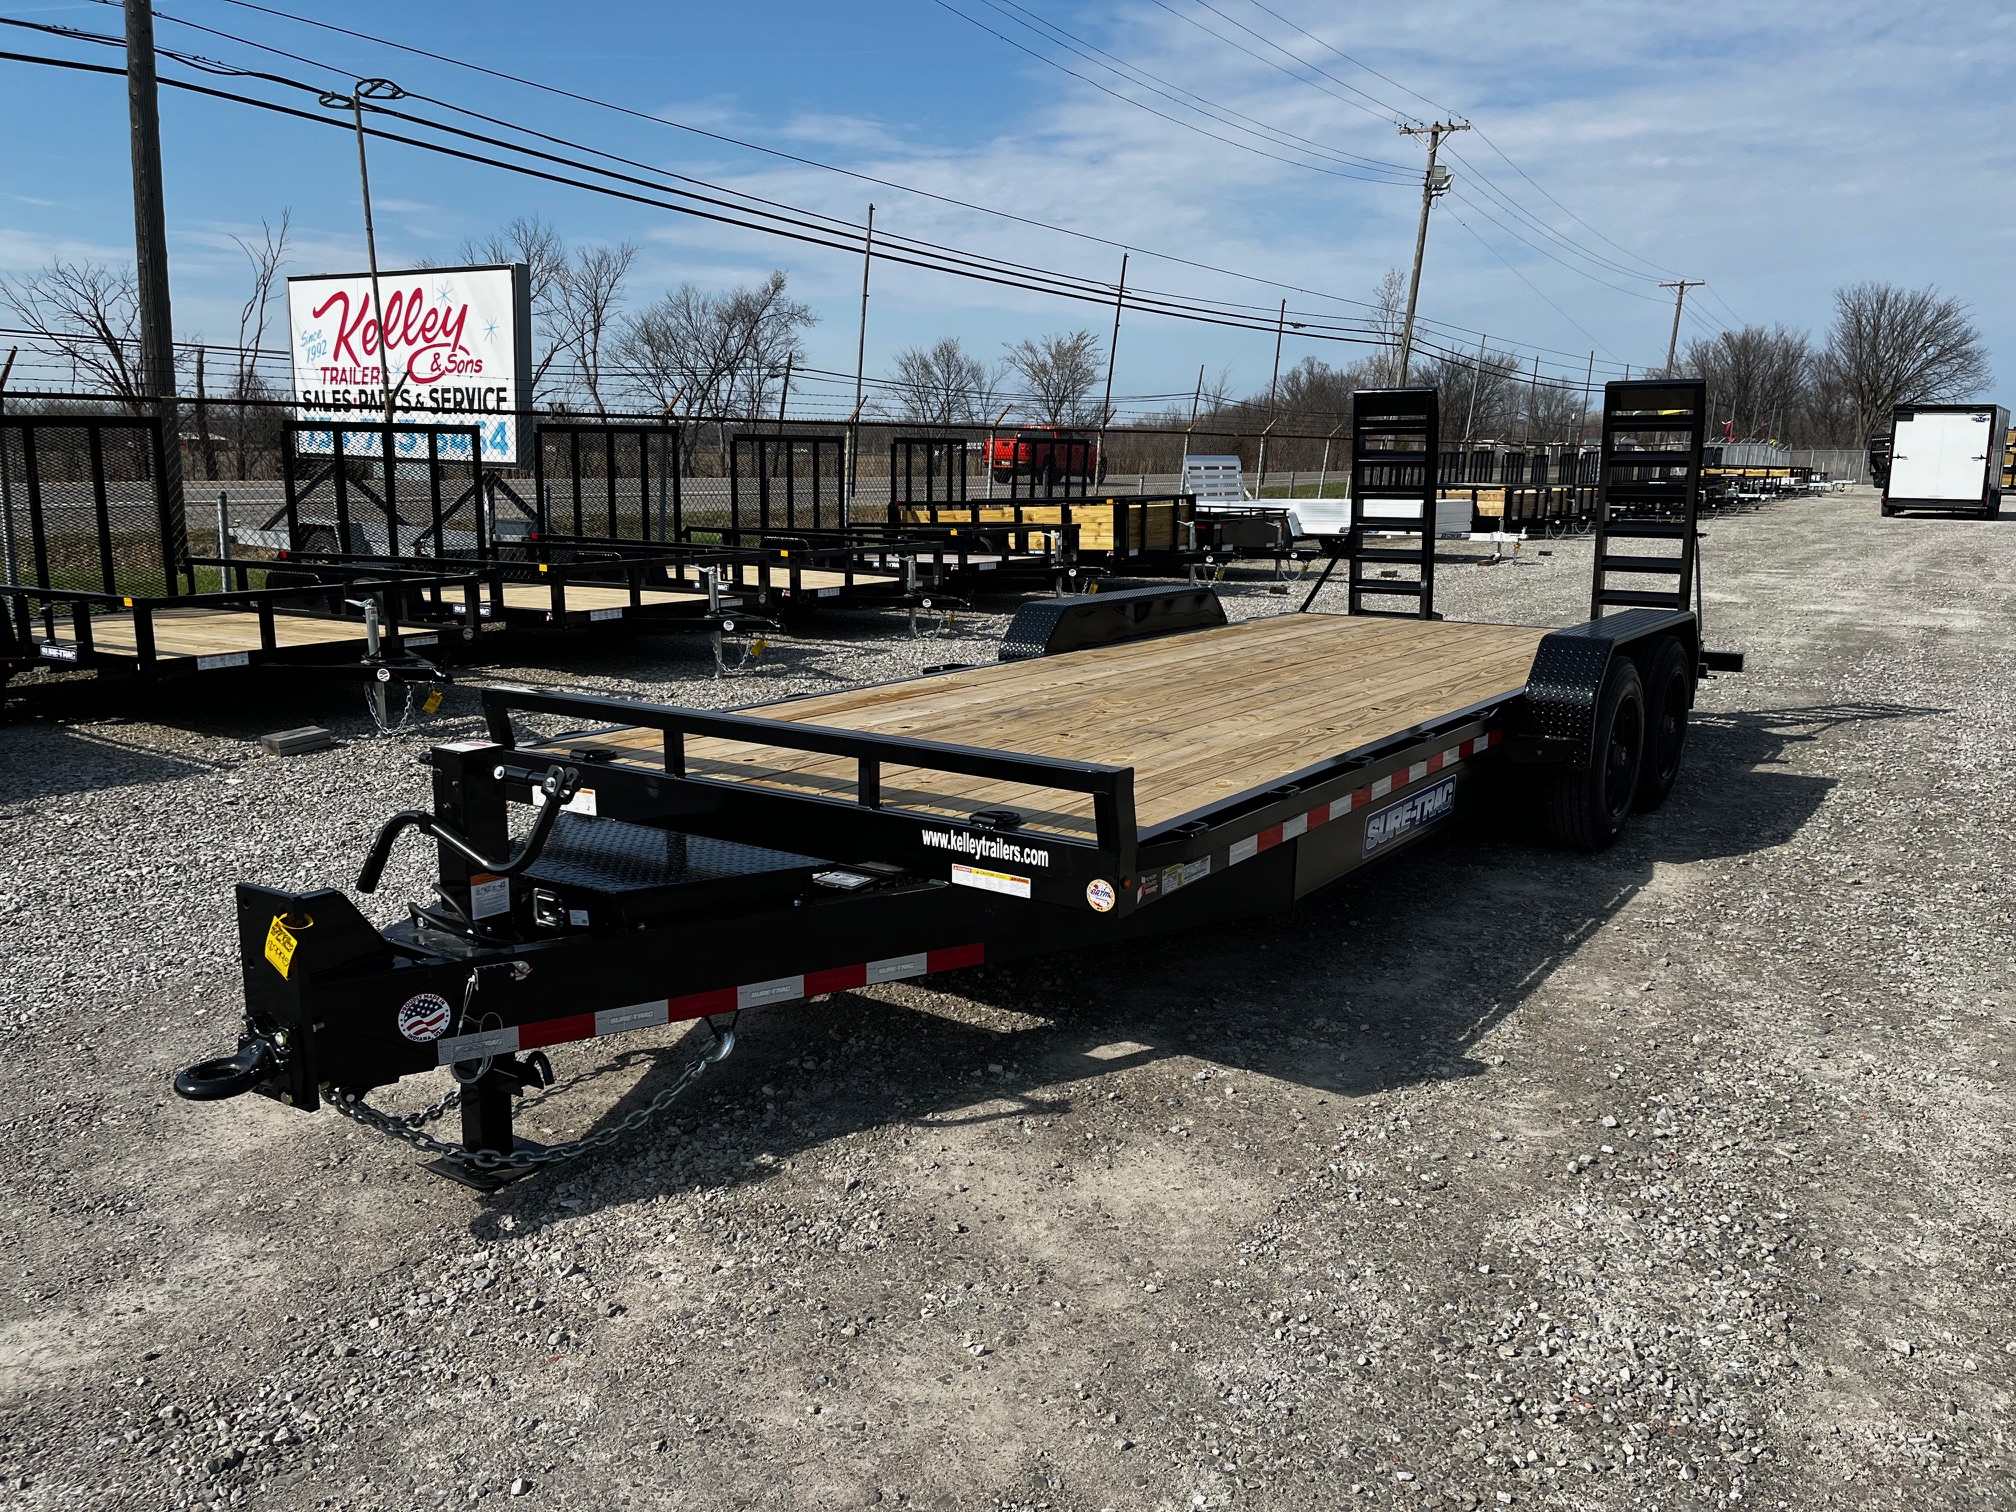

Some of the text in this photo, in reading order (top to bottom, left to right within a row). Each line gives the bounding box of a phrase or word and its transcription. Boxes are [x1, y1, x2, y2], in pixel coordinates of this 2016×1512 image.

[300, 329, 322, 348] Since
[312, 287, 468, 368] Kelley
[306, 340, 327, 363] 1992
[430, 352, 483, 374] & Sons
[429, 387, 507, 415] SERVICE
[1366, 781, 1454, 850] SURE-TRAC
[922, 829, 1049, 867] www.kelleytrailers.com
[878, 962, 915, 975] SURE-TRAC
[751, 985, 791, 999] SURE-TRAC
[609, 1011, 654, 1024] SURE-TRAC
